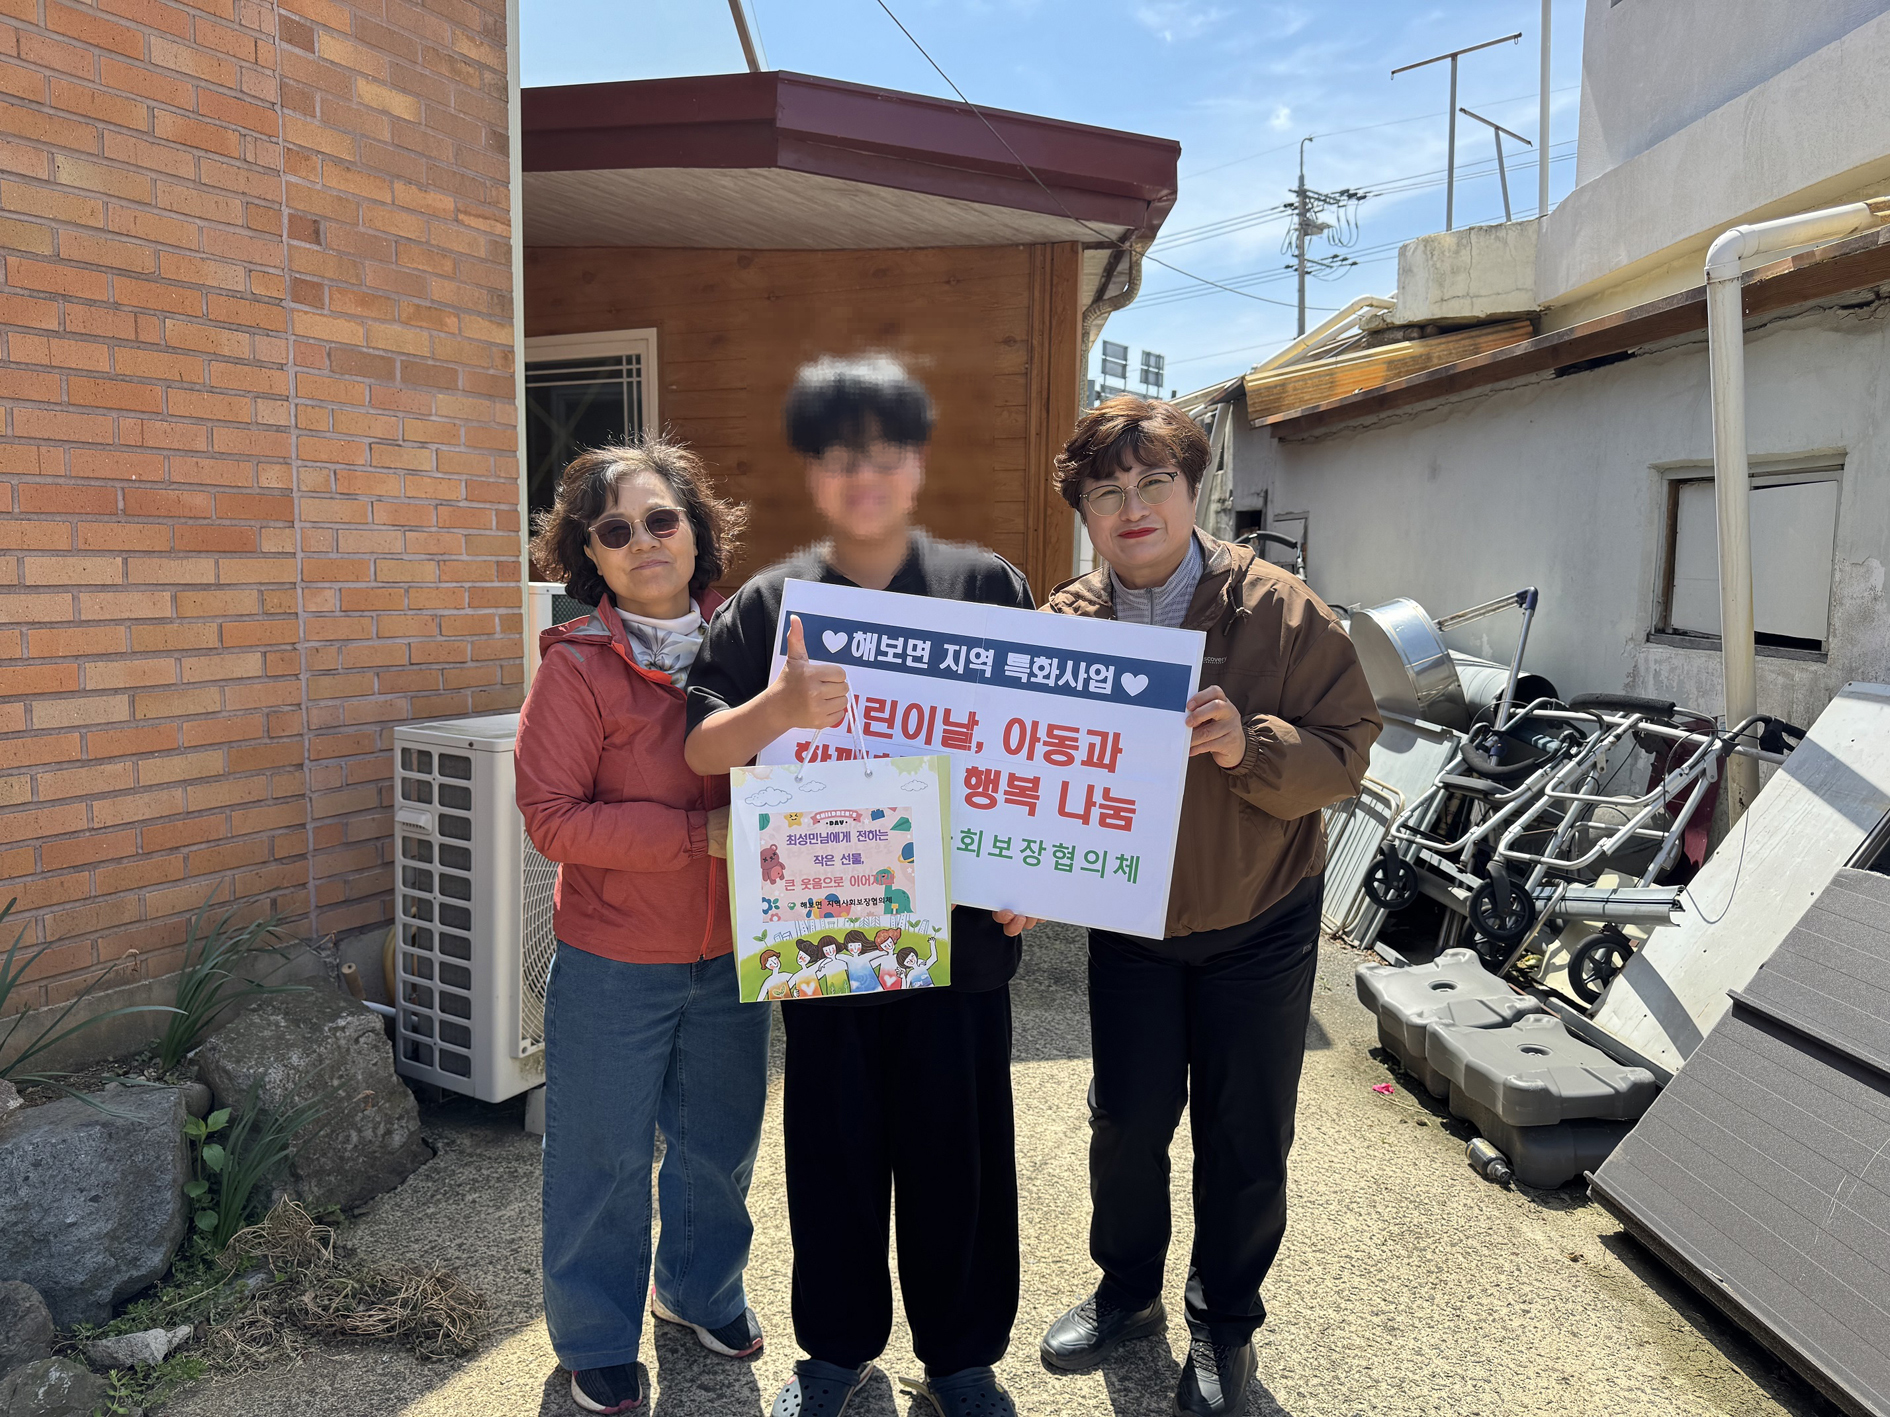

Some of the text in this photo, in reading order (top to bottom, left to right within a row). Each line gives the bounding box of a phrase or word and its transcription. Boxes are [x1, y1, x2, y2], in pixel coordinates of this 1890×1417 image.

[851, 630, 1115, 694] 해보면 지역 특화사업
[1002, 717, 1123, 774] 아동과
[963, 765, 1137, 832] 행복 나눔
[786, 829, 889, 846] 최성민님에게 전하는
[813, 853, 865, 868] 작은 선물,
[951, 828, 1141, 885] 회보장협의체
[784, 879, 796, 892] 큰
[800, 876, 844, 891] 웃음으로
[800, 896, 893, 909] 해보면 지역사회보장협의체
